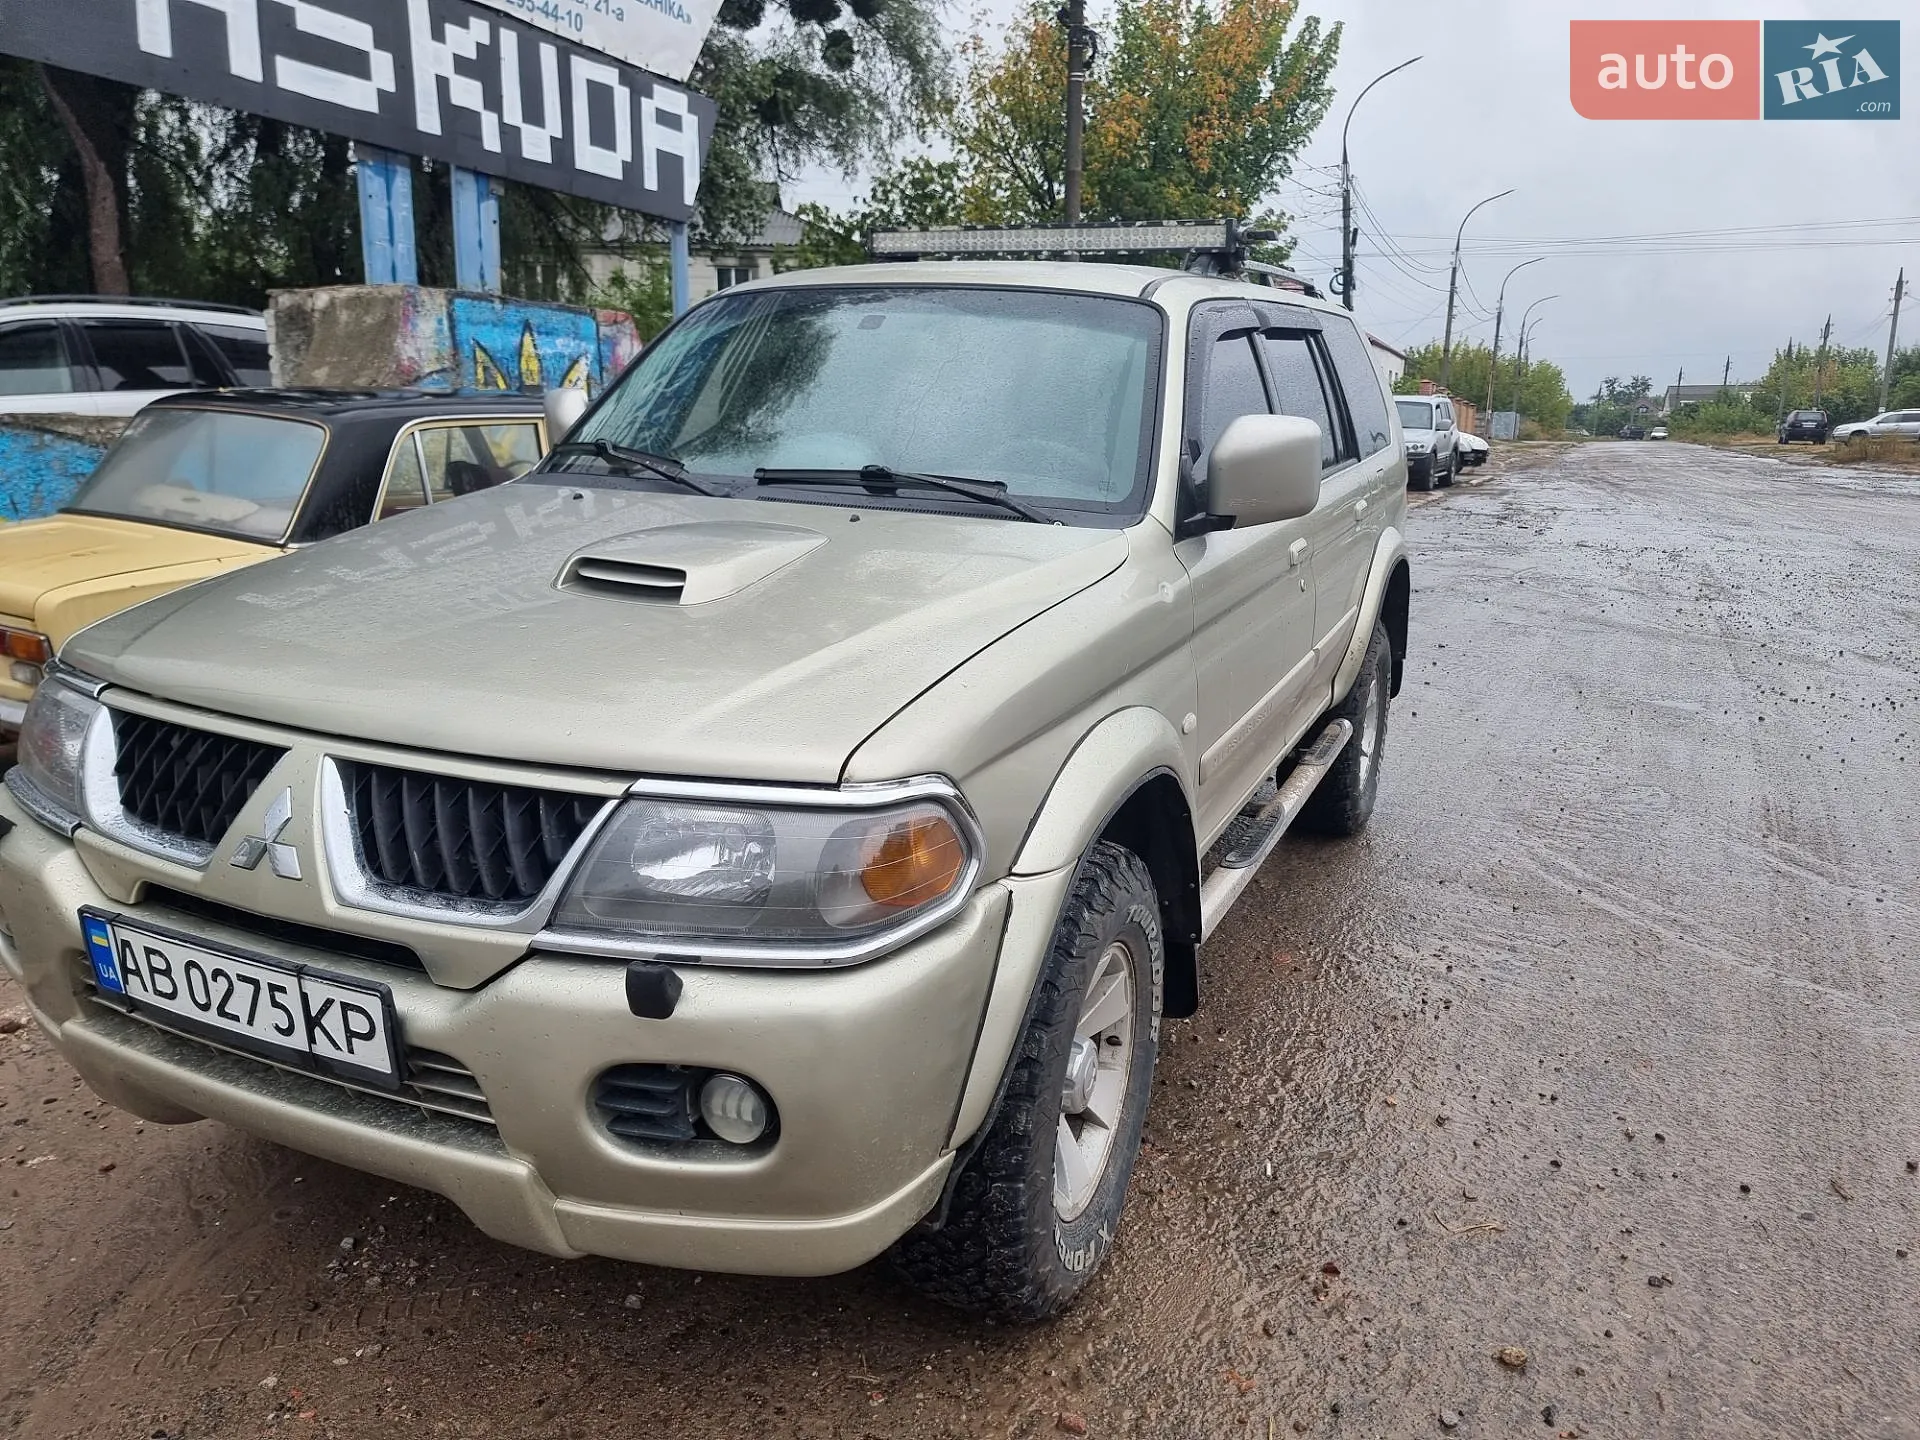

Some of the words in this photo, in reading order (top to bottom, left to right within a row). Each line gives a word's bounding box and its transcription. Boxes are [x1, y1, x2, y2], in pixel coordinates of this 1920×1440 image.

[506, 0, 583, 32] 5-44-10
[100, 963, 118, 982] UA
[118, 938, 178, 1000] AB
[184, 959, 296, 1037] 0275
[302, 991, 376, 1055] KP
